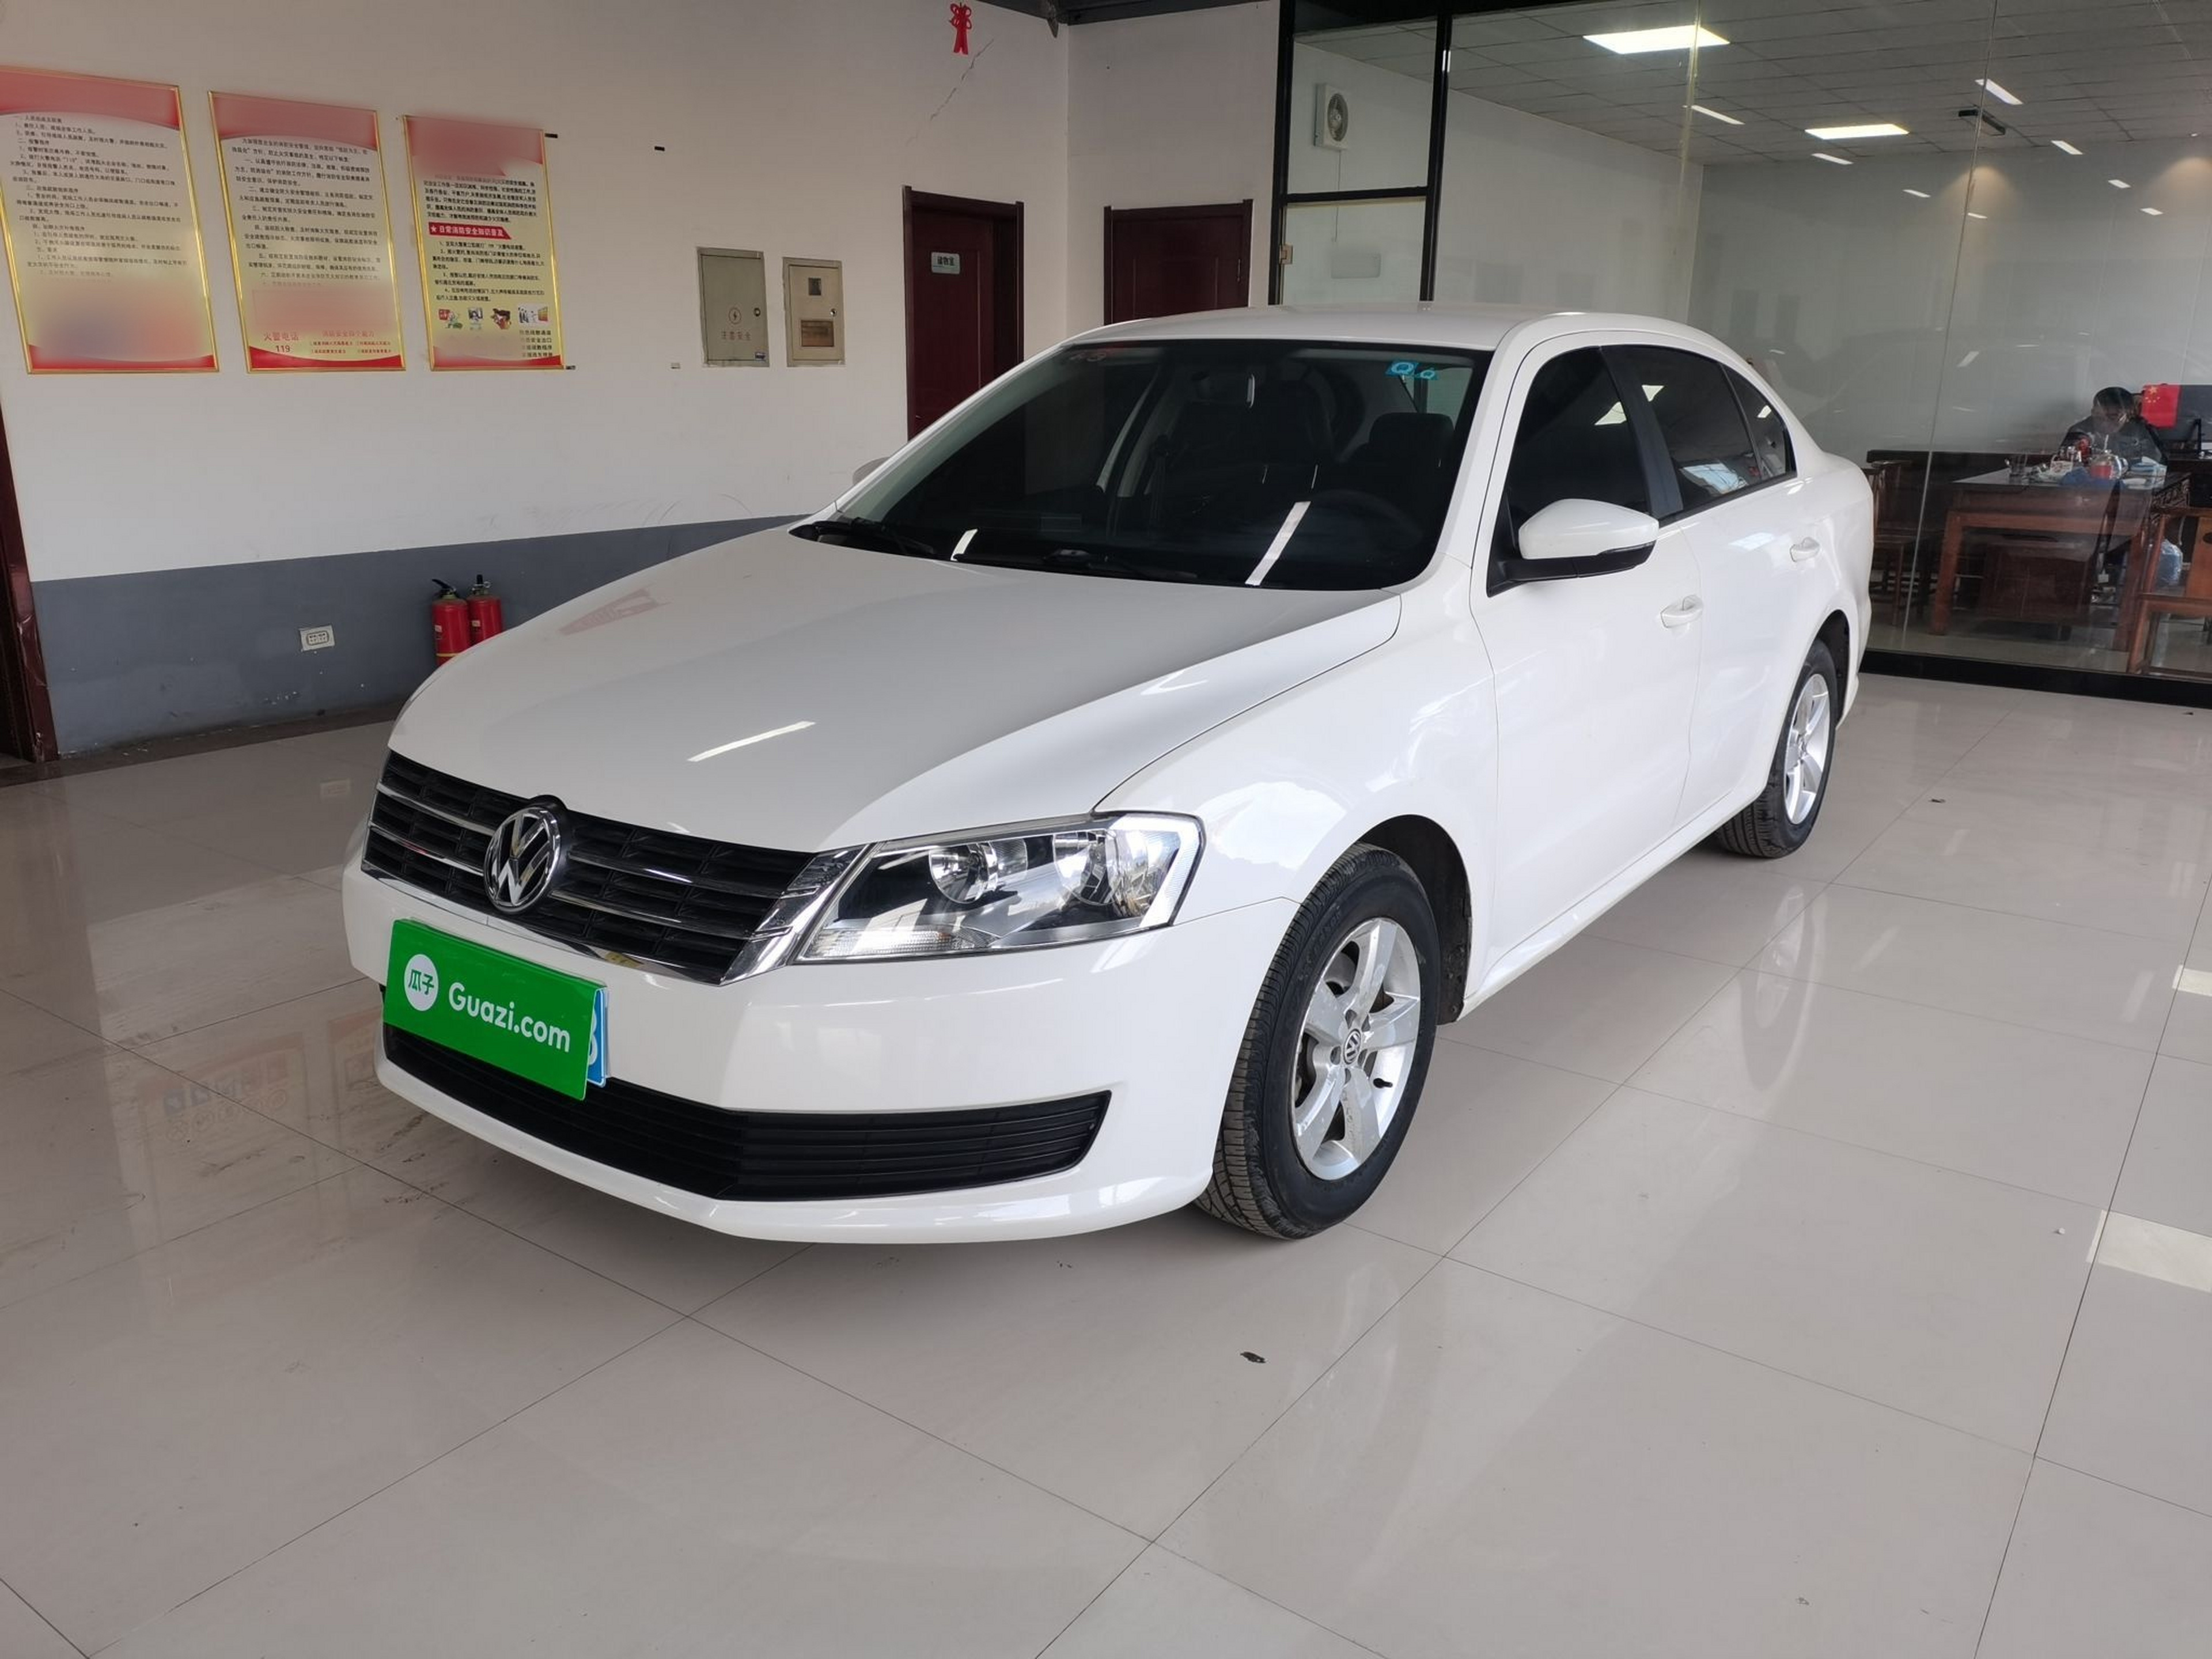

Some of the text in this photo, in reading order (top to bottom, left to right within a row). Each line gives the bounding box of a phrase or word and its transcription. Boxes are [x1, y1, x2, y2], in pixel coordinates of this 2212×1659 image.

[275, 344, 291, 353] 119
[408, 969, 435, 995] 瓜子
[449, 982, 570, 1053] Guazi.com
